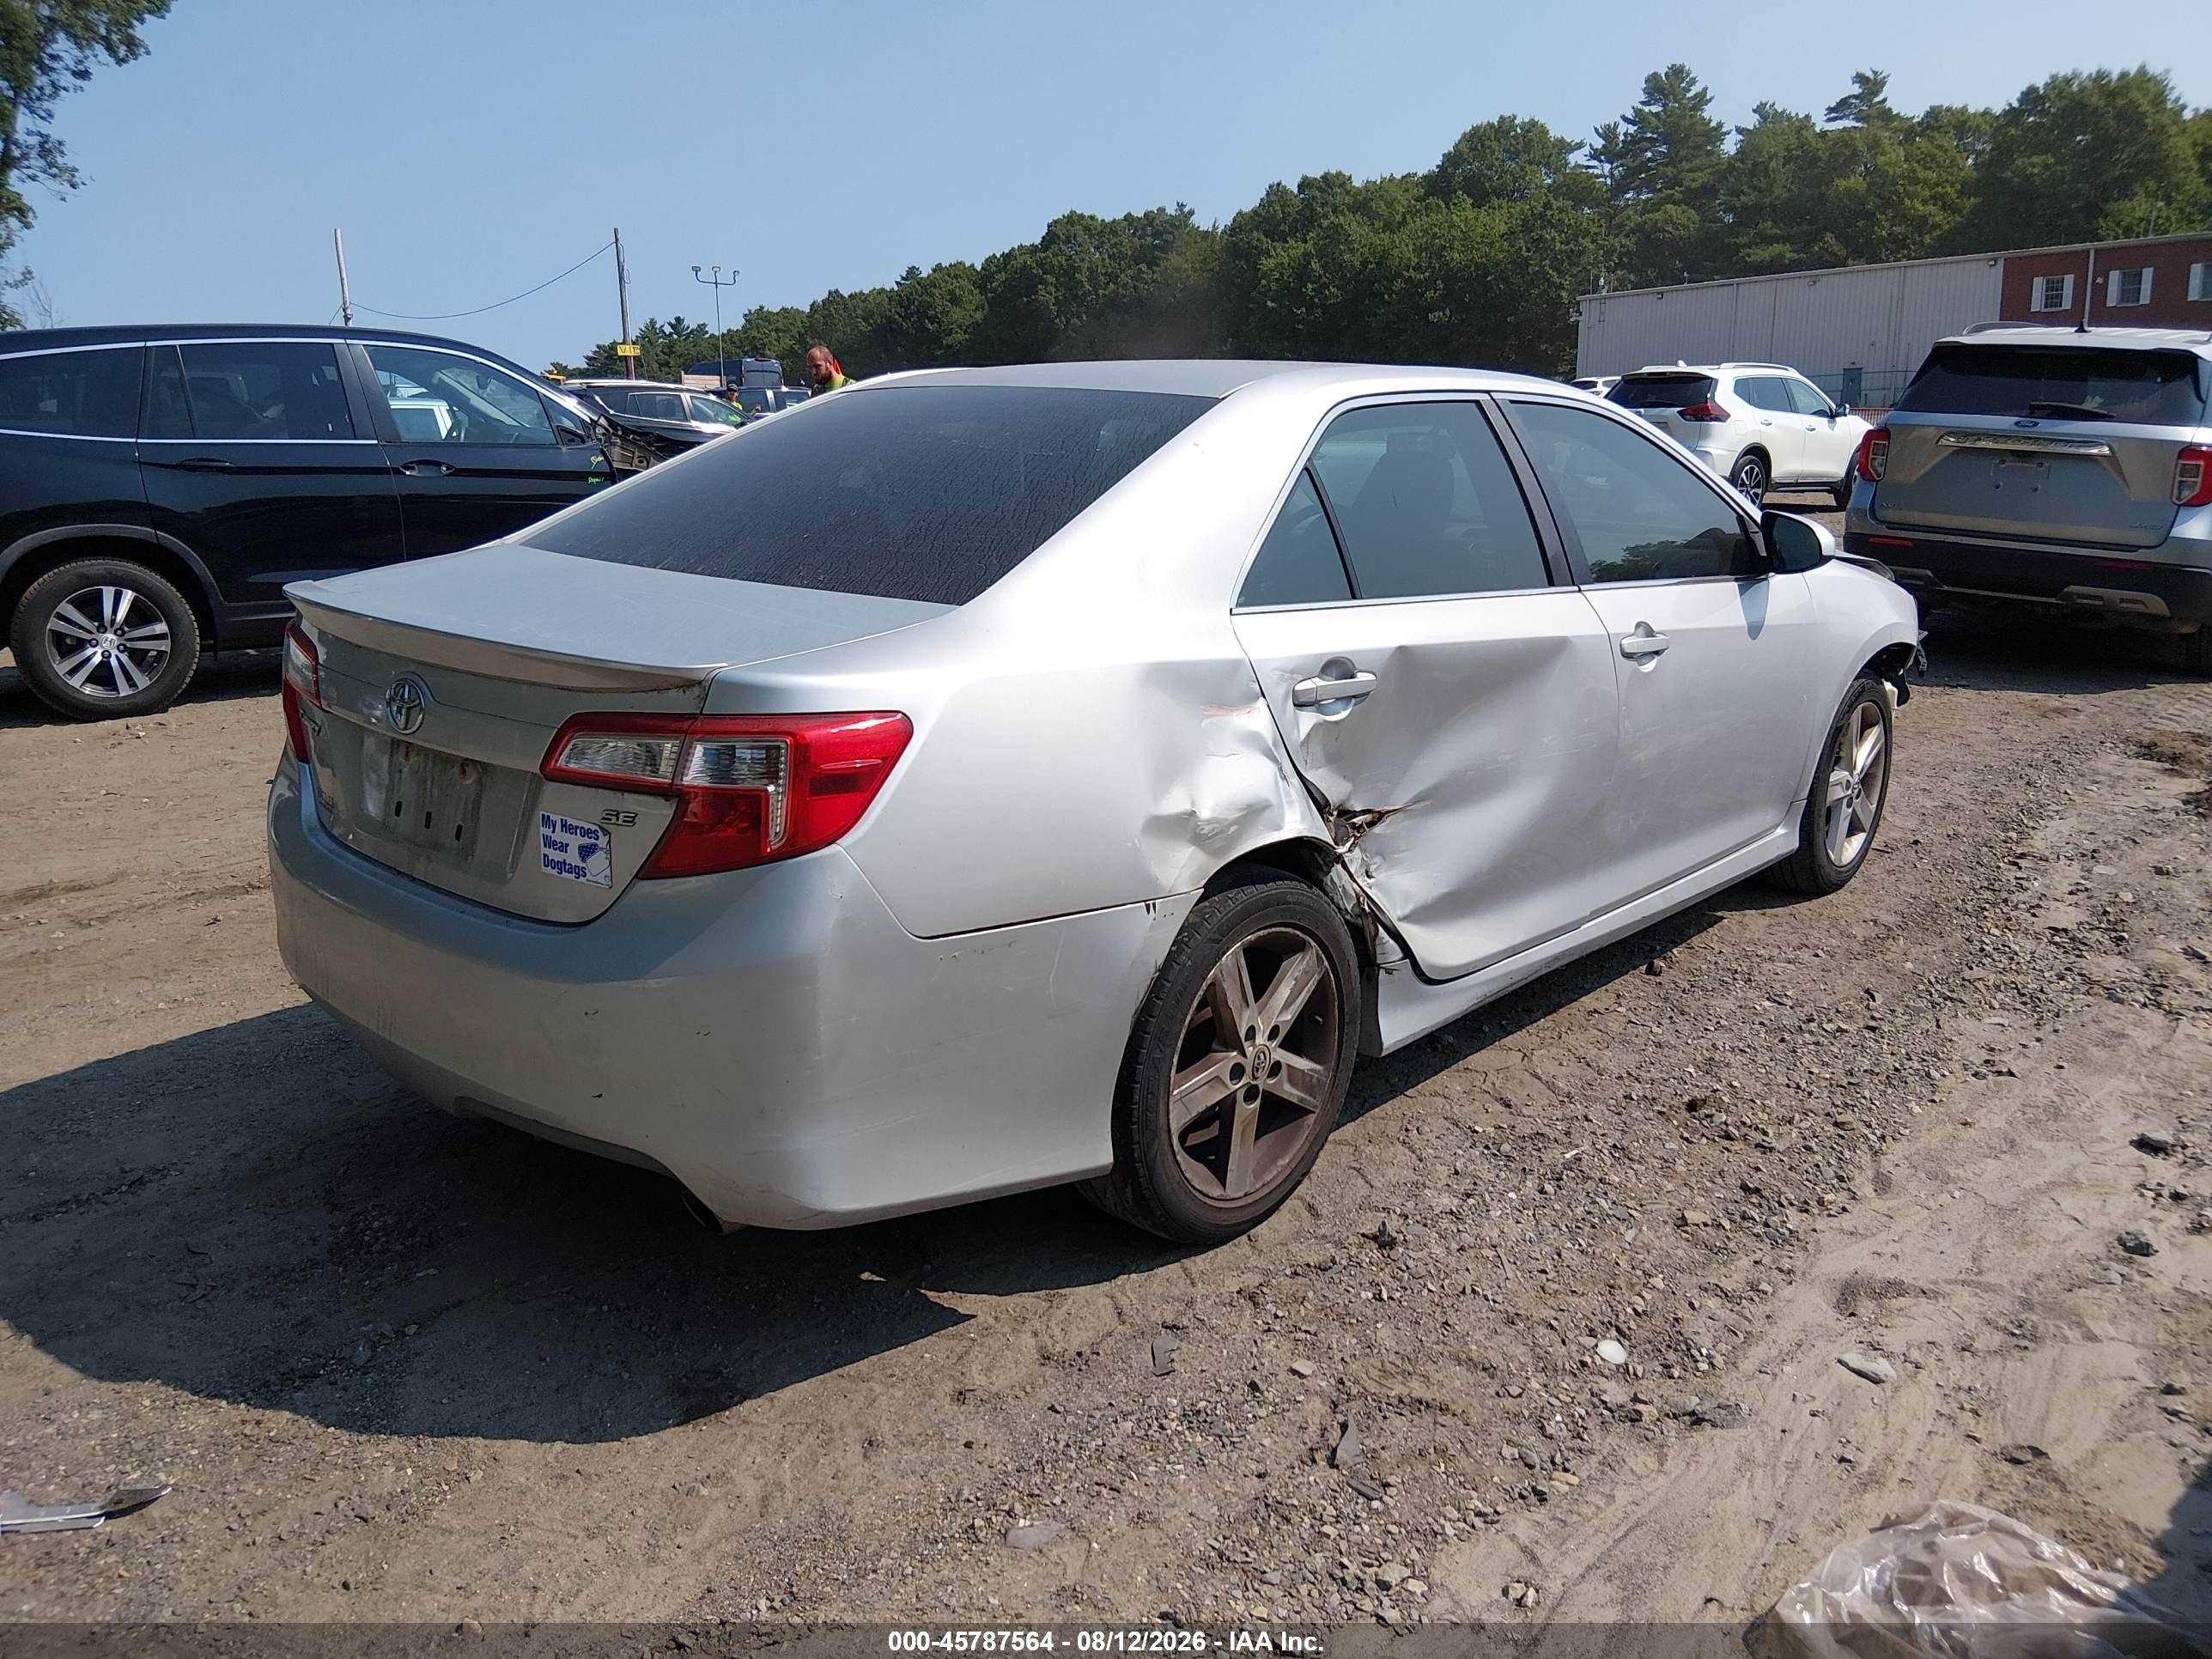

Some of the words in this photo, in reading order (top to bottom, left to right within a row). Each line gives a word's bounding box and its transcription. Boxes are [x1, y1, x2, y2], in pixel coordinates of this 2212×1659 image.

[541, 813, 557, 834] My
[560, 817, 599, 841] Heroes
[601, 808, 638, 827] SE
[542, 833, 570, 854] Wear
[543, 853, 587, 879] Dogtags
